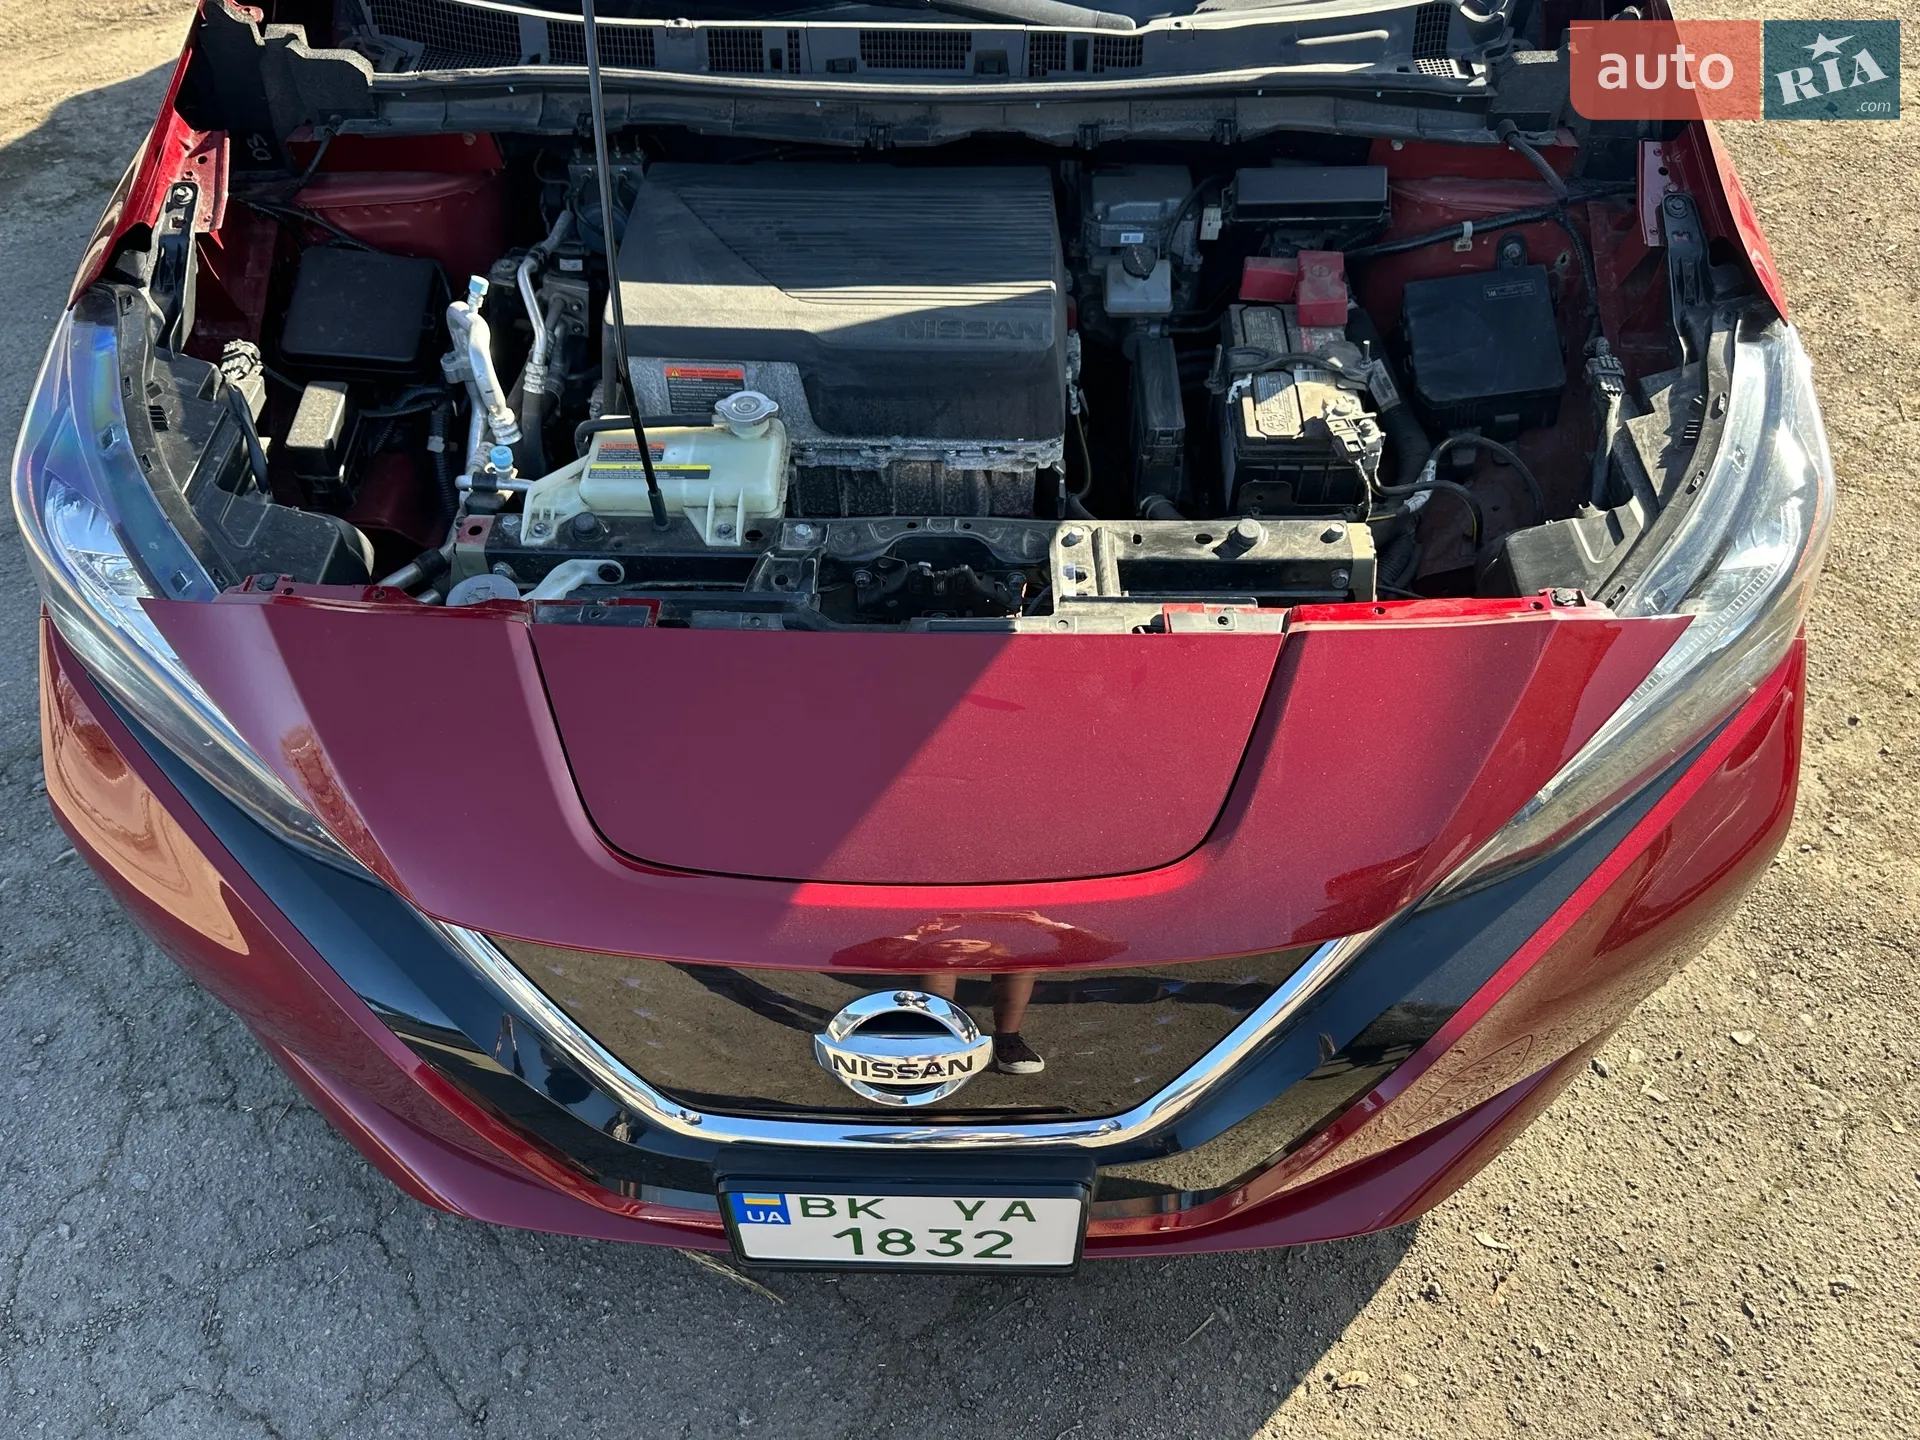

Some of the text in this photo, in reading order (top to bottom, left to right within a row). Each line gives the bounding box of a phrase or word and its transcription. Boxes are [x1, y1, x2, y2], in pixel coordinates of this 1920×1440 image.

[899, 318, 1045, 340] NISSAN
[832, 1053, 973, 1079] NISSAN
[746, 1210, 785, 1224] UA
[799, 1196, 1037, 1222] BK YA
[833, 1227, 1013, 1258] 1832
